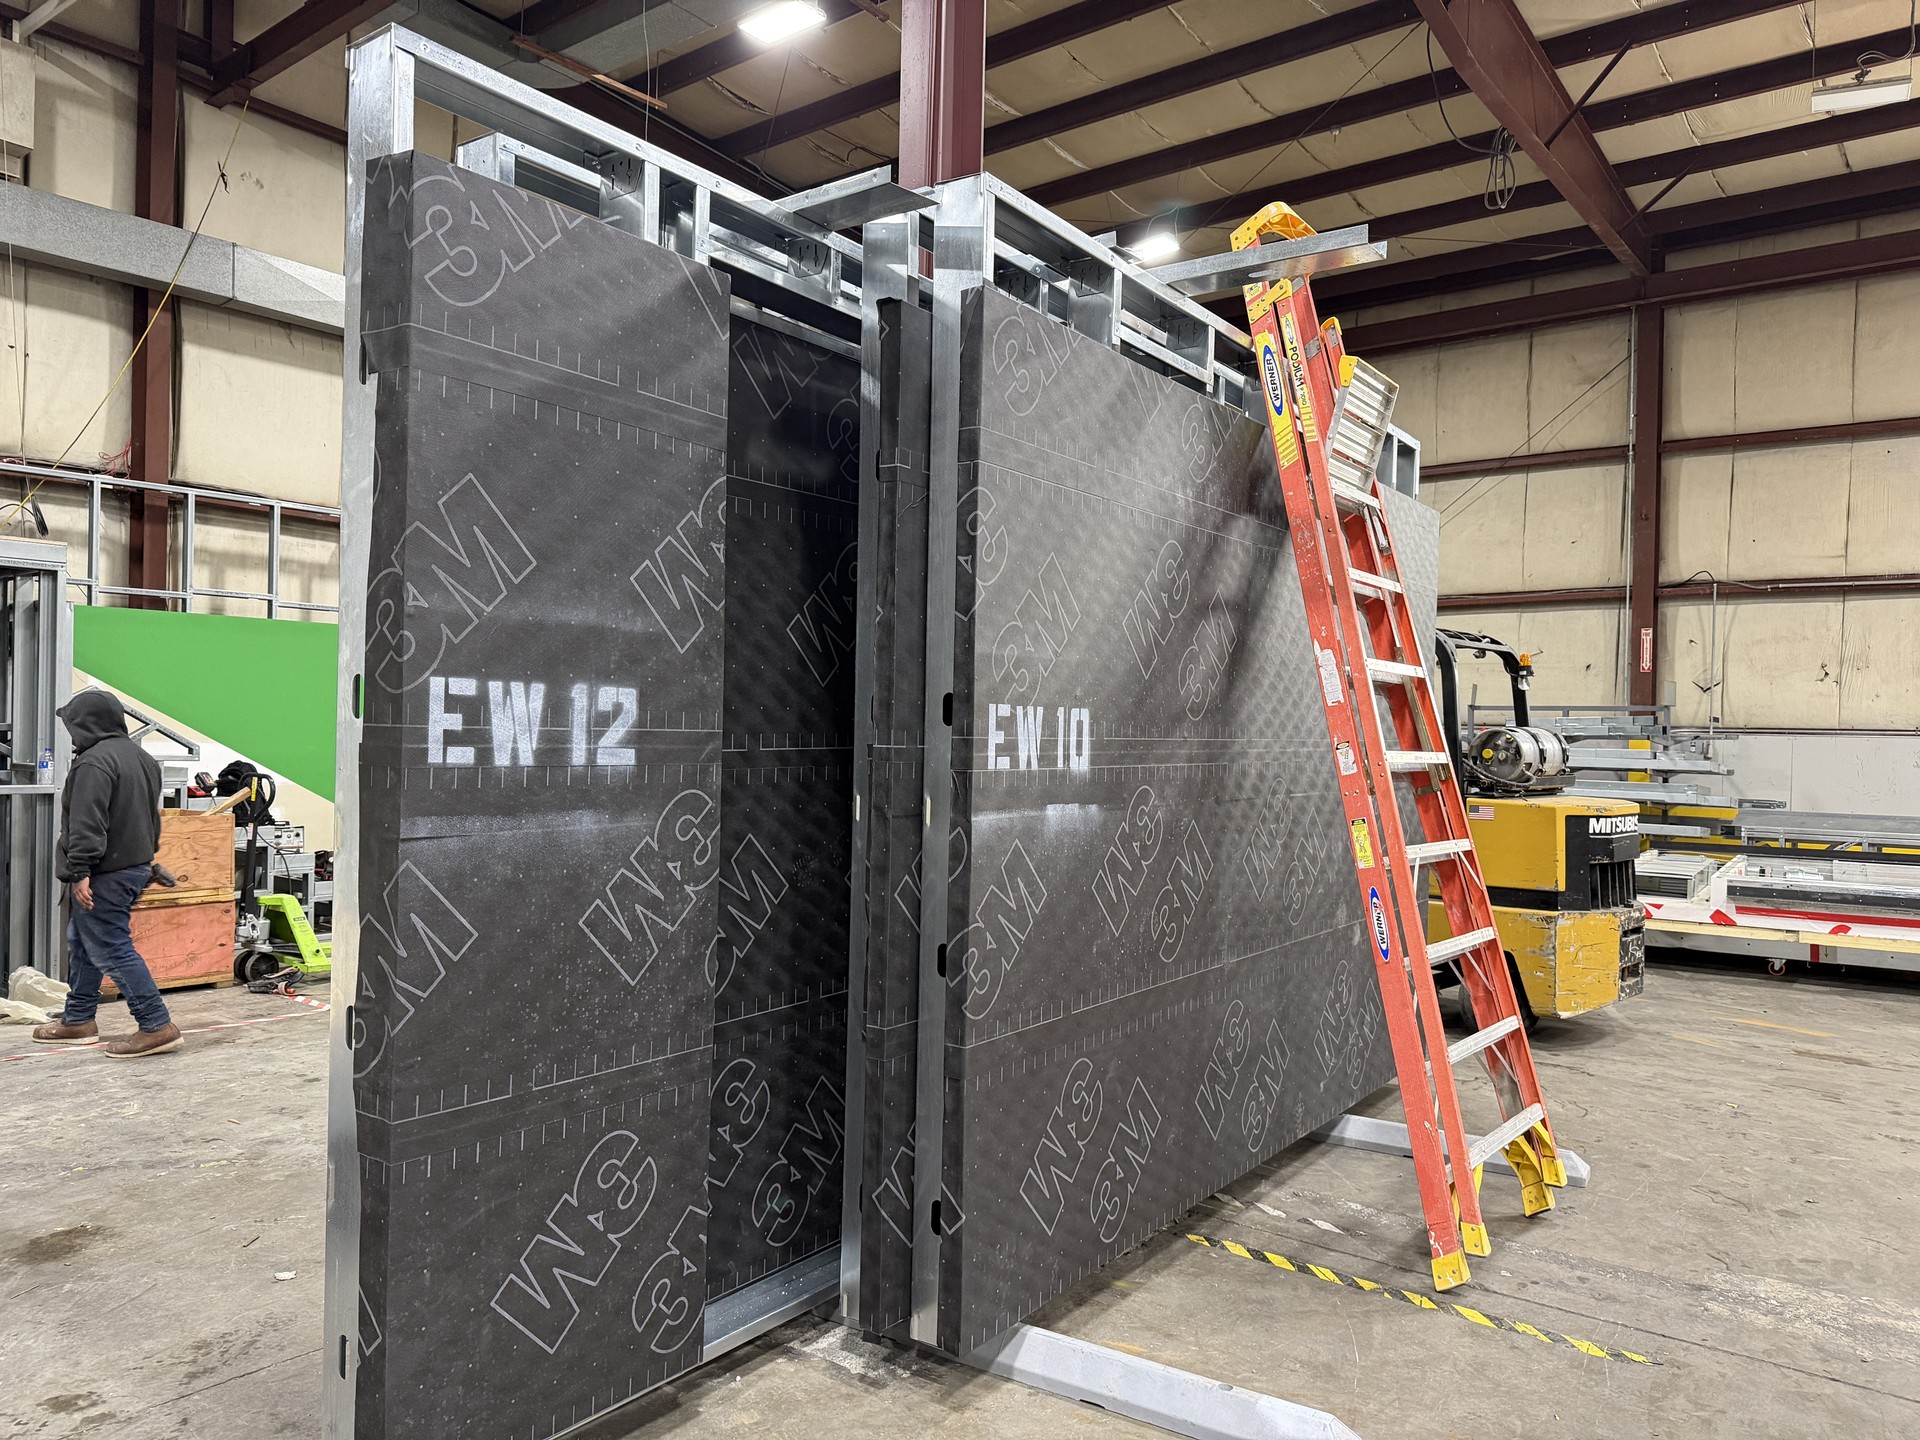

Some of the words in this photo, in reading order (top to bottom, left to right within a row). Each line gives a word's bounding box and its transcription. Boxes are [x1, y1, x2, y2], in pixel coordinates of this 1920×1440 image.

[1266, 358, 1280, 402] WERNER
[364, 473, 538, 694] 3M
[992, 552, 1081, 713] 3M
[1123, 539, 1191, 680] 3M
[427, 676, 545, 768] EW
[571, 682, 638, 768] 12
[1178, 588, 1238, 721] 3M
[988, 703, 1043, 771] EW
[1057, 706, 1091, 770] 10
[579, 788, 721, 986] 3M
[1092, 785, 1164, 937] 3M
[1151, 819, 1214, 962] 3M
[1243, 778, 1291, 902] 3M
[1283, 806, 1327, 926] 3M
[946, 838, 1048, 1020] 3M
[1195, 1000, 1251, 1141] 3M
[1242, 1018, 1291, 1152] 3M
[1313, 959, 1353, 1077] 3M
[1346, 977, 1382, 1090] 3M
[752, 1076, 846, 1247] 3M
[1020, 1057, 1103, 1236] 3M
[1090, 1076, 1162, 1244] 3M
[490, 1129, 658, 1354] 3M
